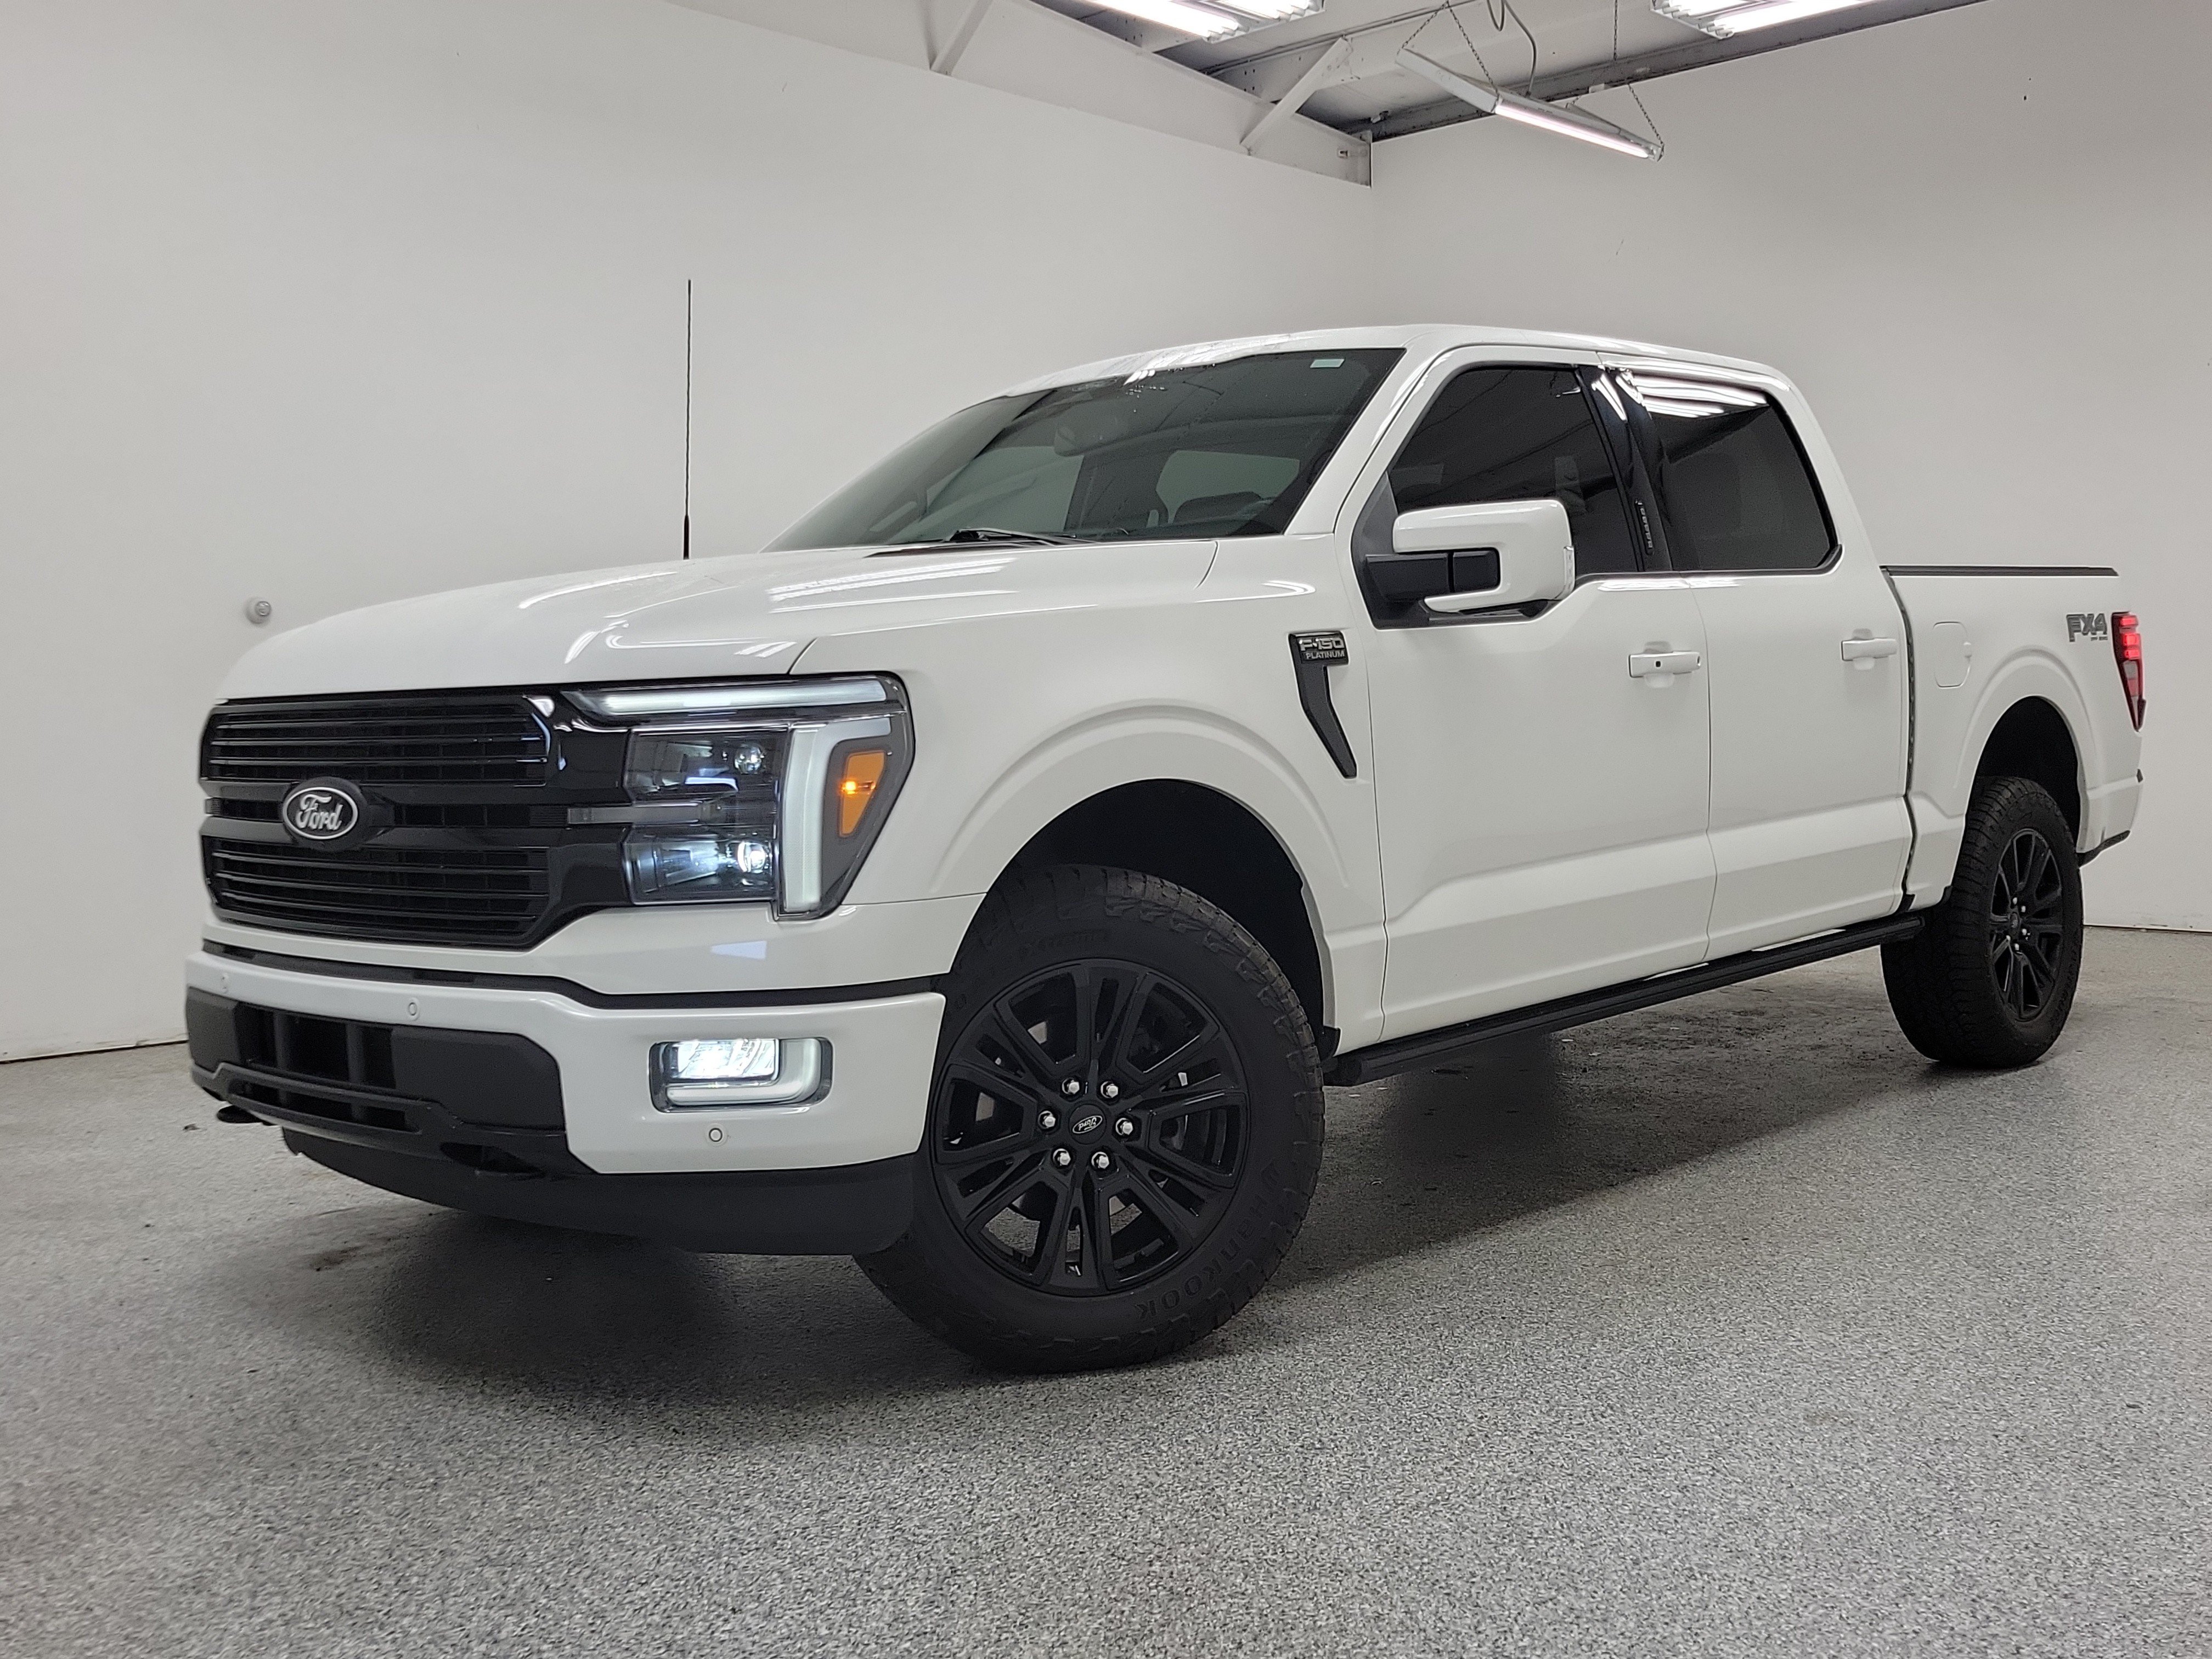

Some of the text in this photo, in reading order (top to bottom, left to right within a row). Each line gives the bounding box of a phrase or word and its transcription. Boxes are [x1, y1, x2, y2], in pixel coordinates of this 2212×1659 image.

[2066, 613, 2108, 642] FX4
[1299, 637, 1345, 652] F-150
[1305, 650, 1345, 660] PLATINUM
[295, 794, 343, 831] Ford
[1077, 1116, 1097, 1131] Ford
